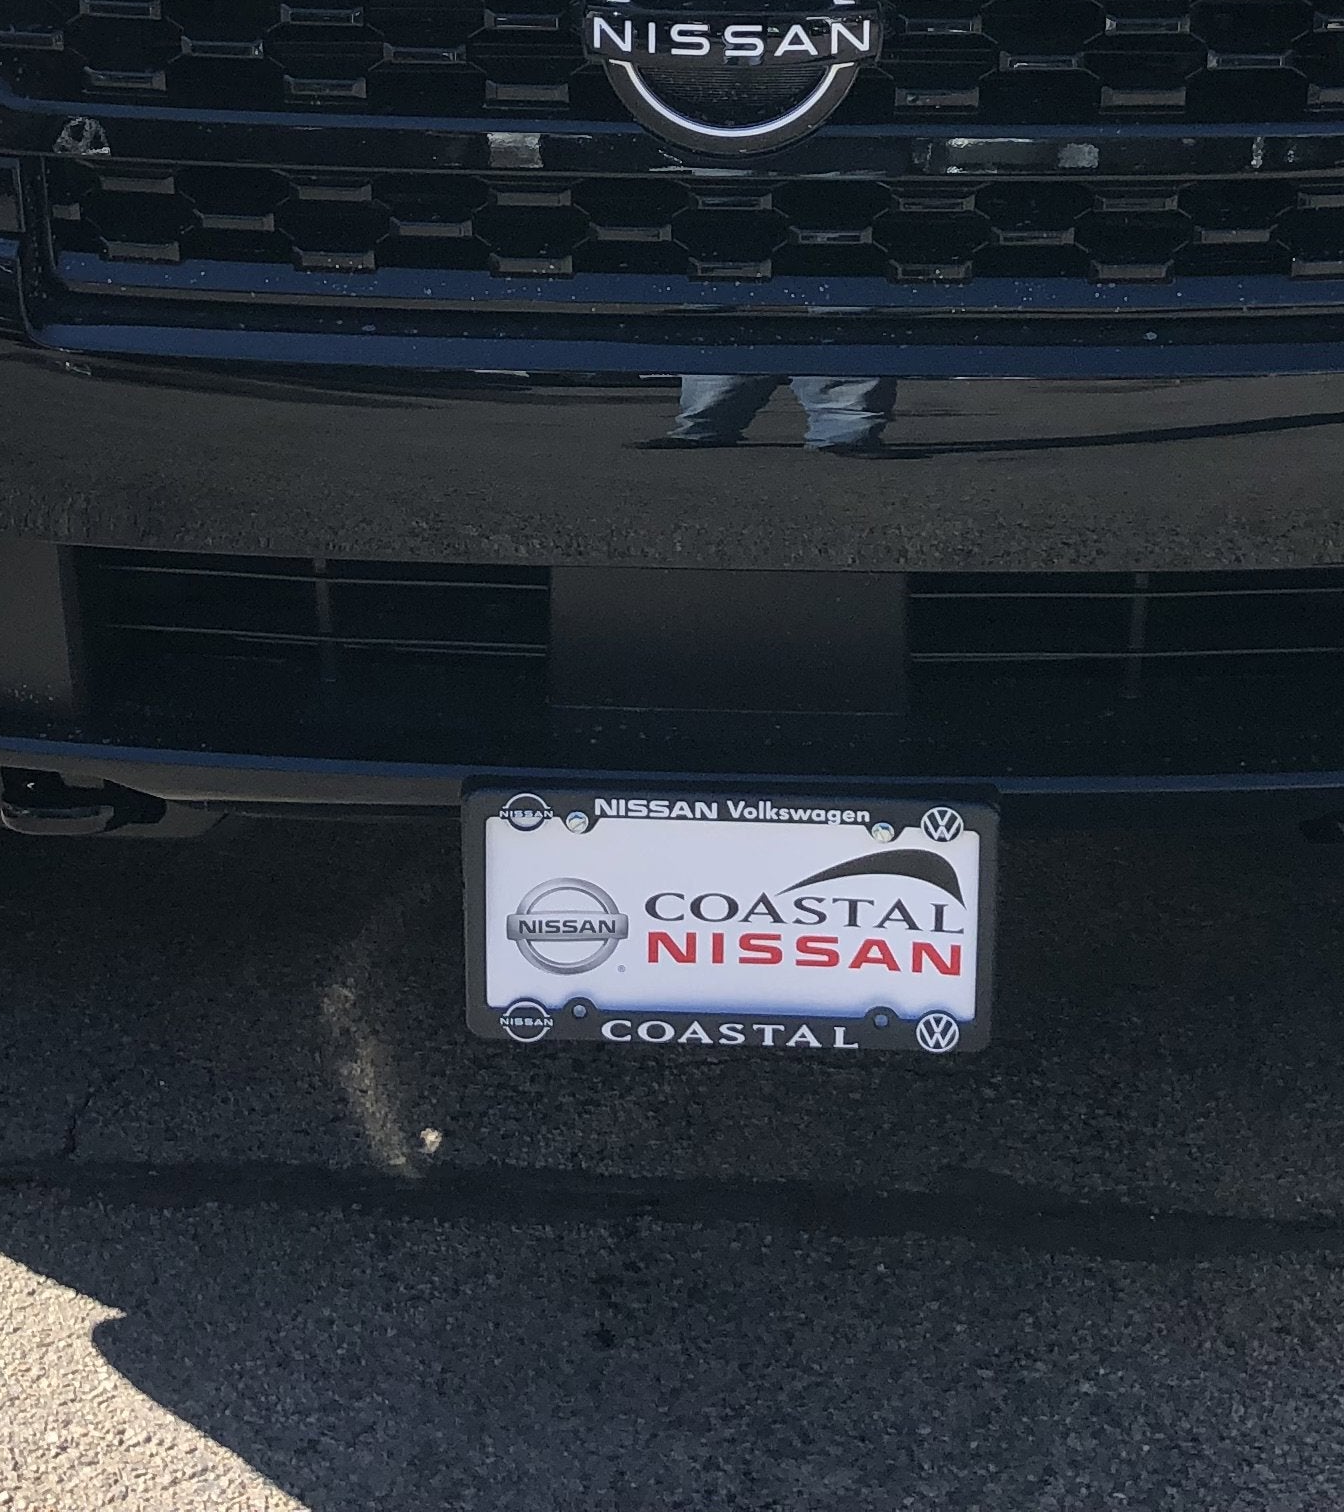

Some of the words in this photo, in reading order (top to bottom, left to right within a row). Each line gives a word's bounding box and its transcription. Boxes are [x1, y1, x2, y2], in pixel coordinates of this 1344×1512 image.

[593, 16, 871, 57] NISSAN
[499, 810, 554, 818] NISSAN
[594, 798, 718, 819] NISSAN
[726, 800, 871, 825] Volkswagen
[517, 918, 617, 935] NISSAN
[644, 892, 965, 934] COASTAL
[647, 931, 962, 976] NISSAN
[499, 1017, 554, 1026] NISSAN
[601, 1019, 859, 1049] COASTAL
